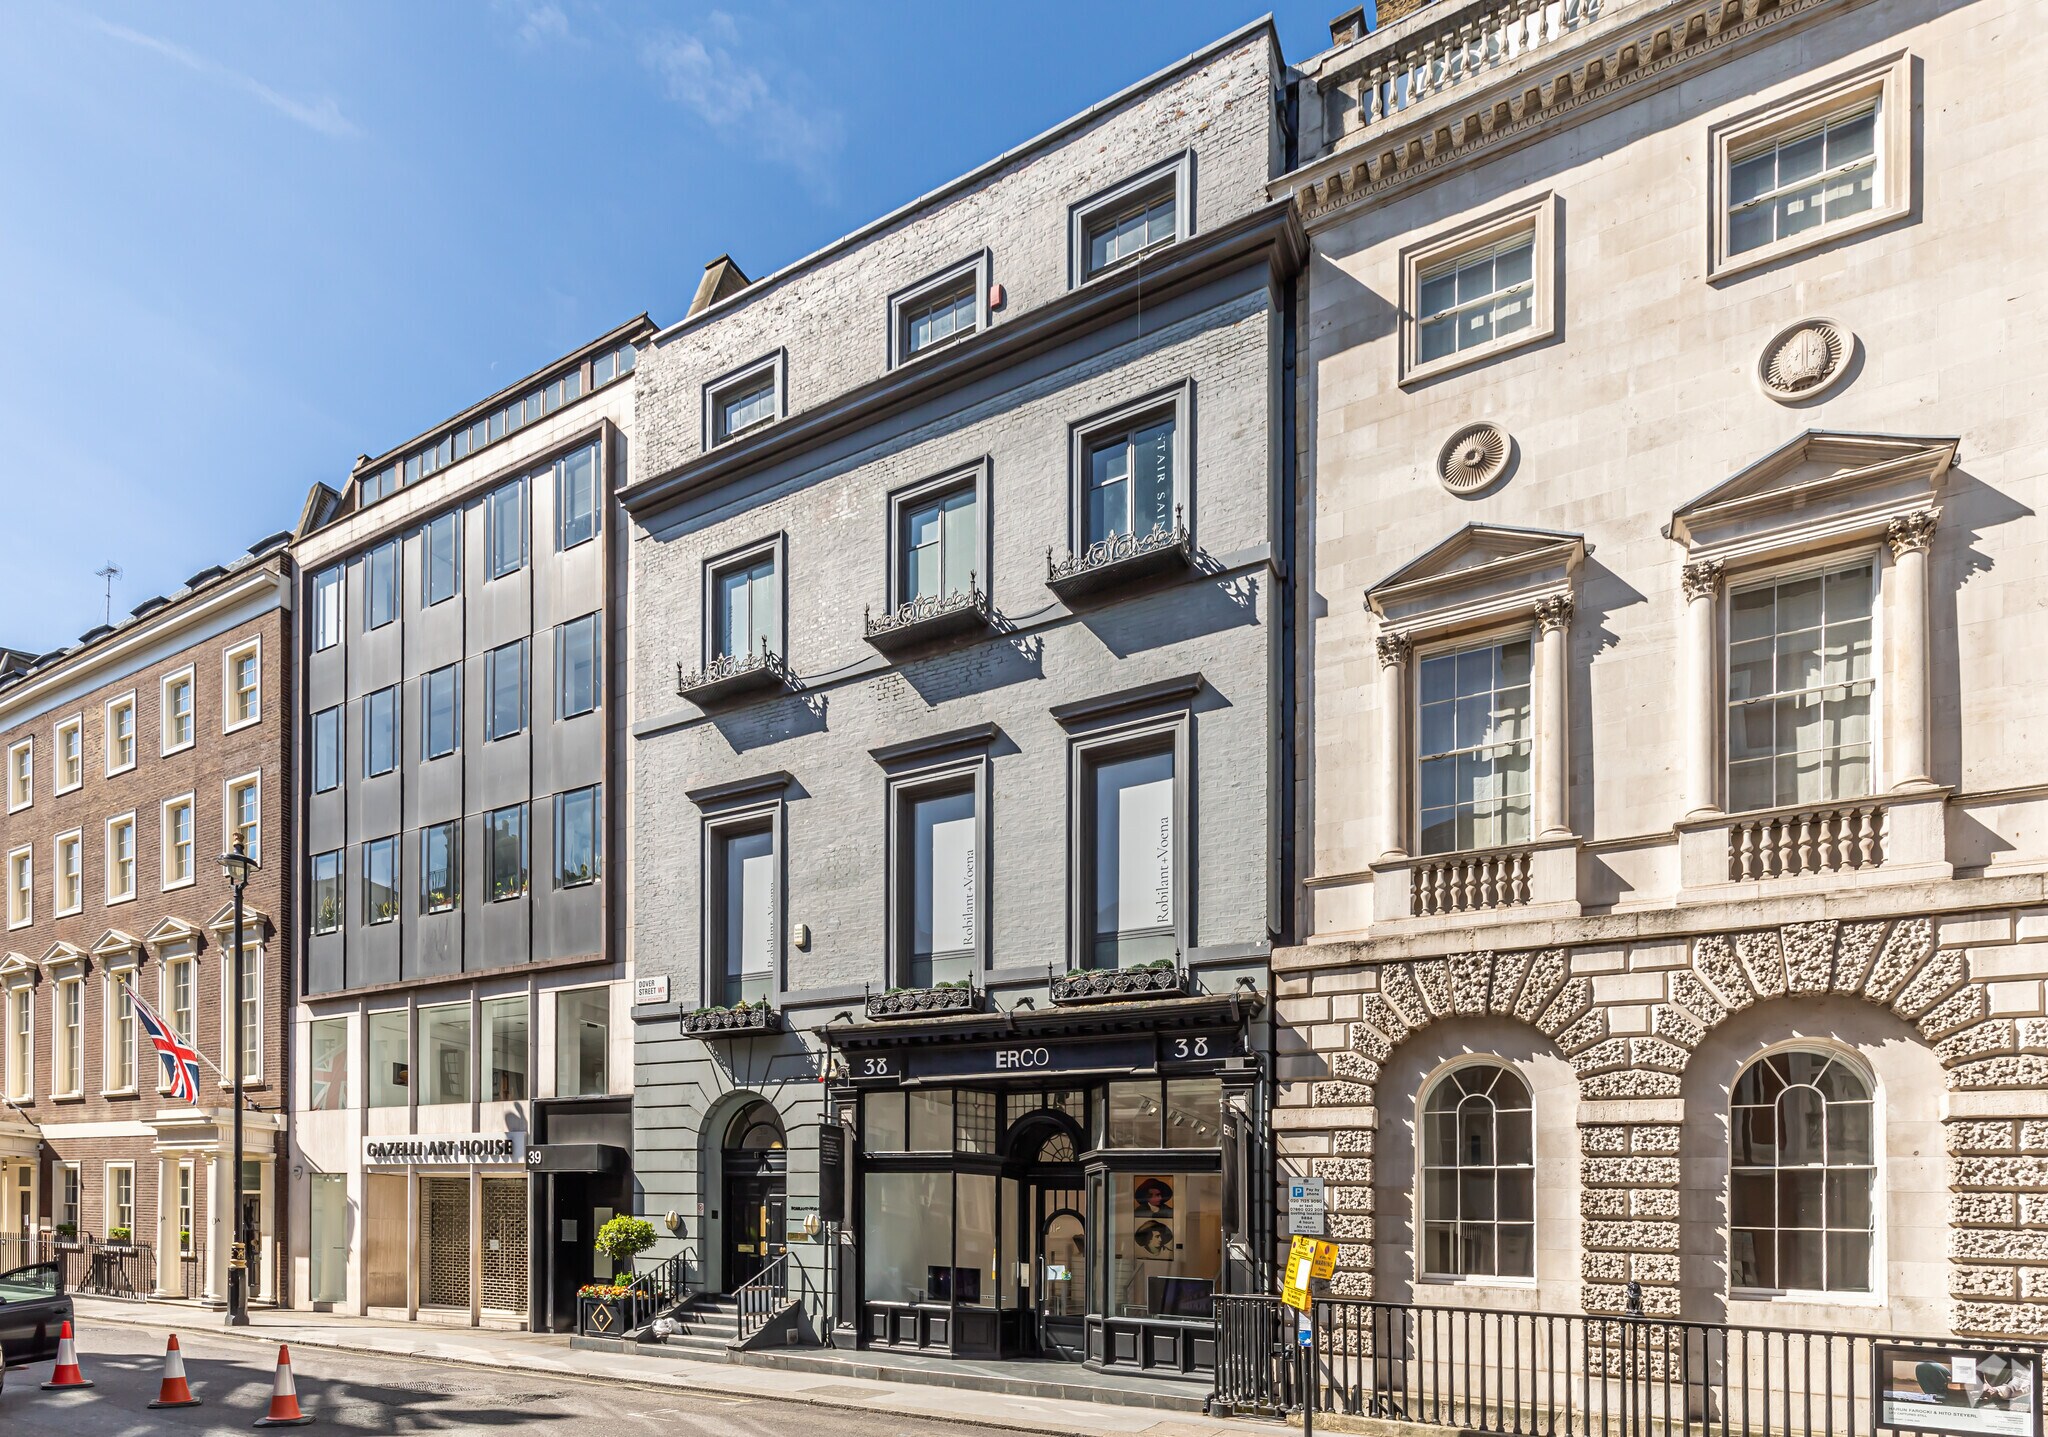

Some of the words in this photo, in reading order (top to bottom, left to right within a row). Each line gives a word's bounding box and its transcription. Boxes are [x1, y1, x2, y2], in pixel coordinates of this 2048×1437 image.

[1157, 432, 1166, 484] STAIR
[1156, 816, 1168, 922] Robilant+Voena
[962, 849, 974, 945] Robilant+Voena
[638, 980, 655, 988] DOVER
[639, 987, 656, 995] STREET
[1174, 1037, 1208, 1058] 38
[864, 1058, 888, 1075] 38
[996, 1047, 1049, 1068] ERCO
[367, 1141, 423, 1157] GAZELLI
[428, 1140, 455, 1156] ART
[459, 1139, 513, 1155] HOUSE
[528, 1150, 542, 1165] 39
